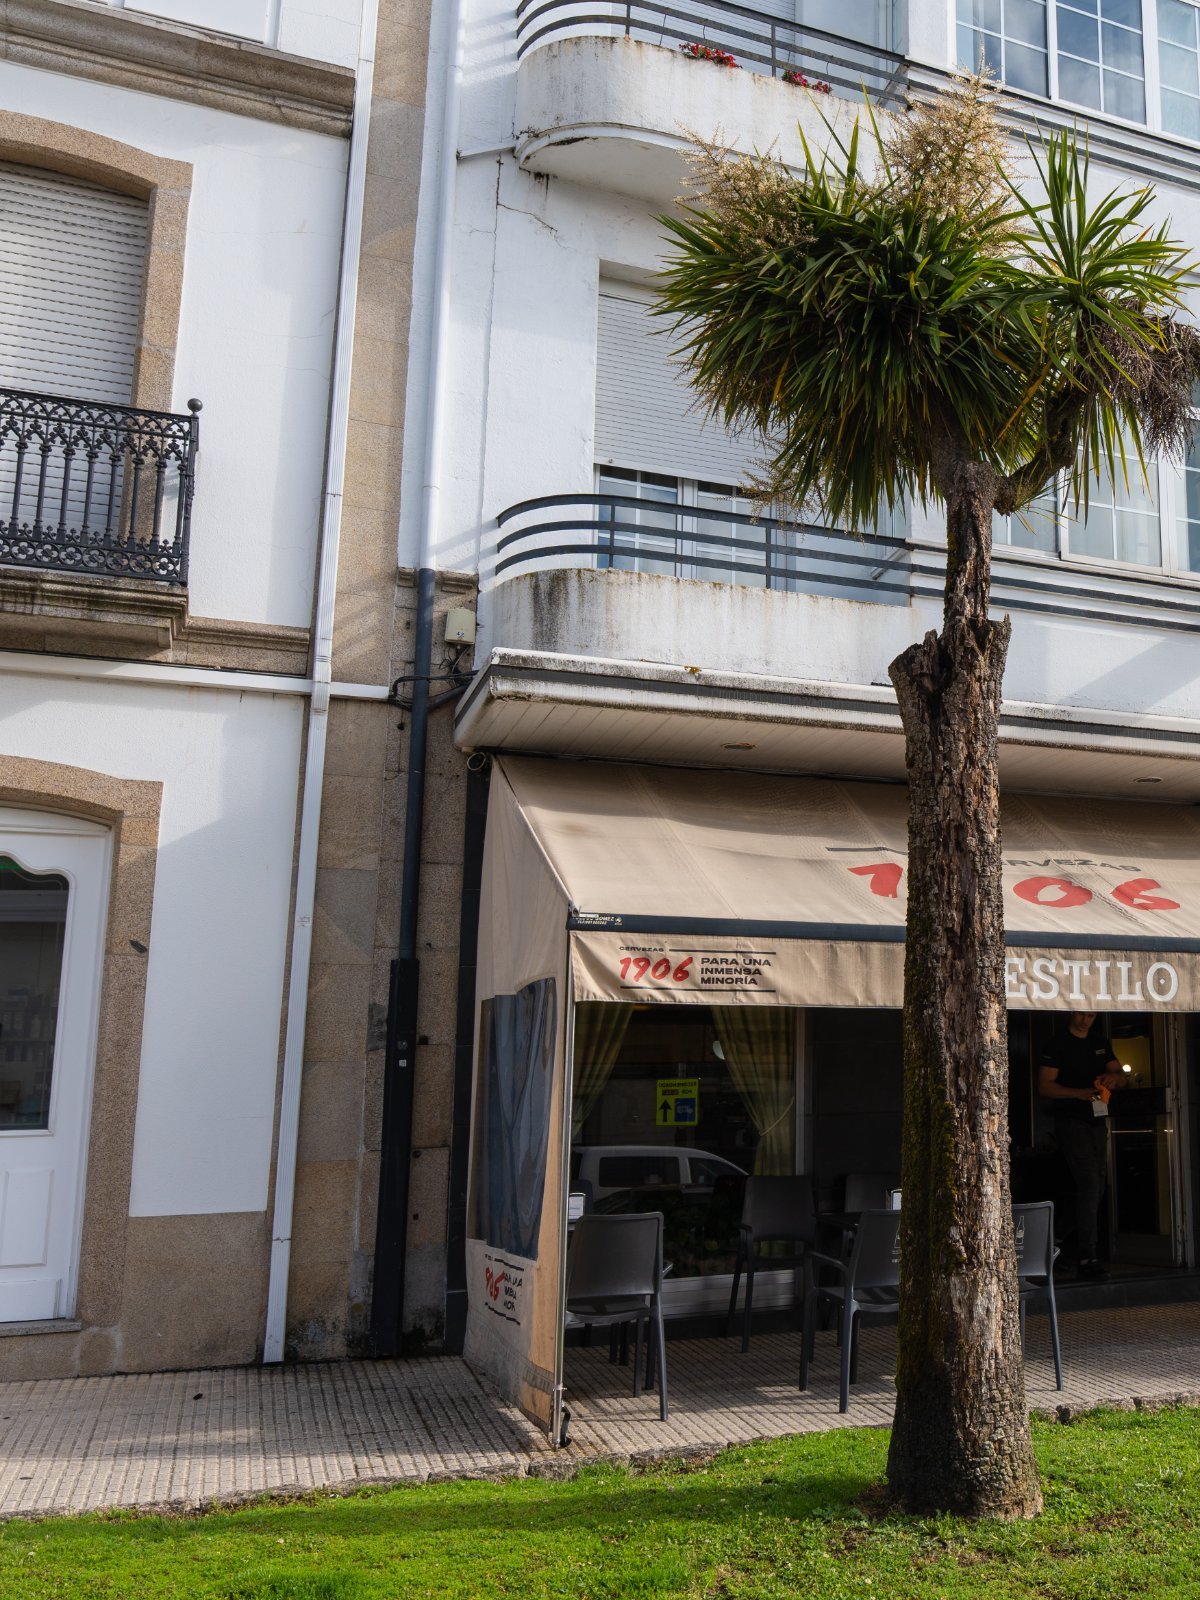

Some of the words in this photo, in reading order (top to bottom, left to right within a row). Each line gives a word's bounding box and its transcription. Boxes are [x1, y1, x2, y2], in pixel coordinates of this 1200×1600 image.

[1001, 859, 1142, 872] RVEZAS
[847, 862, 1181, 911] 106
[700, 957, 740, 966] PARA
[742, 958, 772, 967] UNA
[619, 956, 694, 982] 1906
[700, 967, 763, 976] INMENSA
[700, 976, 758, 985] MINORÍA
[1005, 957, 1180, 1002] ESTILO
